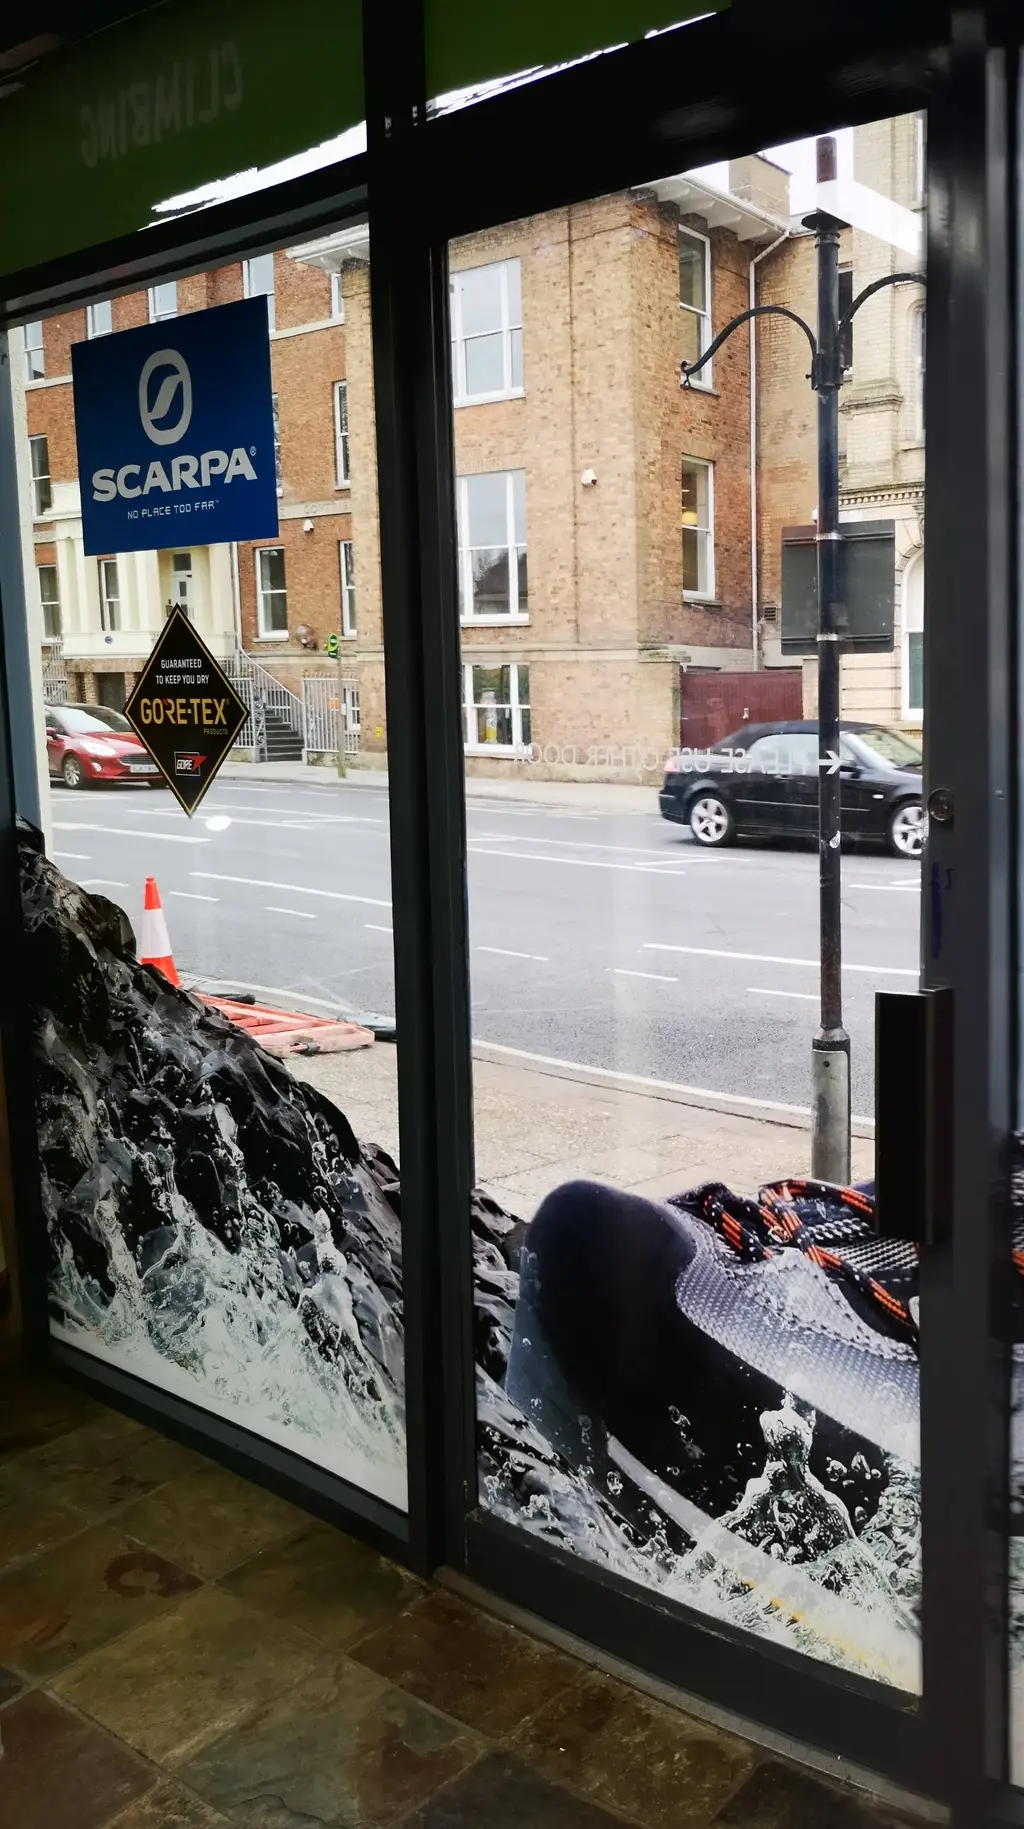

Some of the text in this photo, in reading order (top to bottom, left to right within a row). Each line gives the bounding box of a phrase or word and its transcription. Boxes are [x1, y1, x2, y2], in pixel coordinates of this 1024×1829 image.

[127, 509, 139, 520] NO
[141, 506, 171, 518] PLACE
[173, 503, 192, 514] TOO
[160, 658, 202, 669] GUARANTEED
[155, 674, 210, 685] TO KEEP YOU DRY
[203, 728, 229, 736] PRODUCTS
[176, 759, 193, 770] GORE
